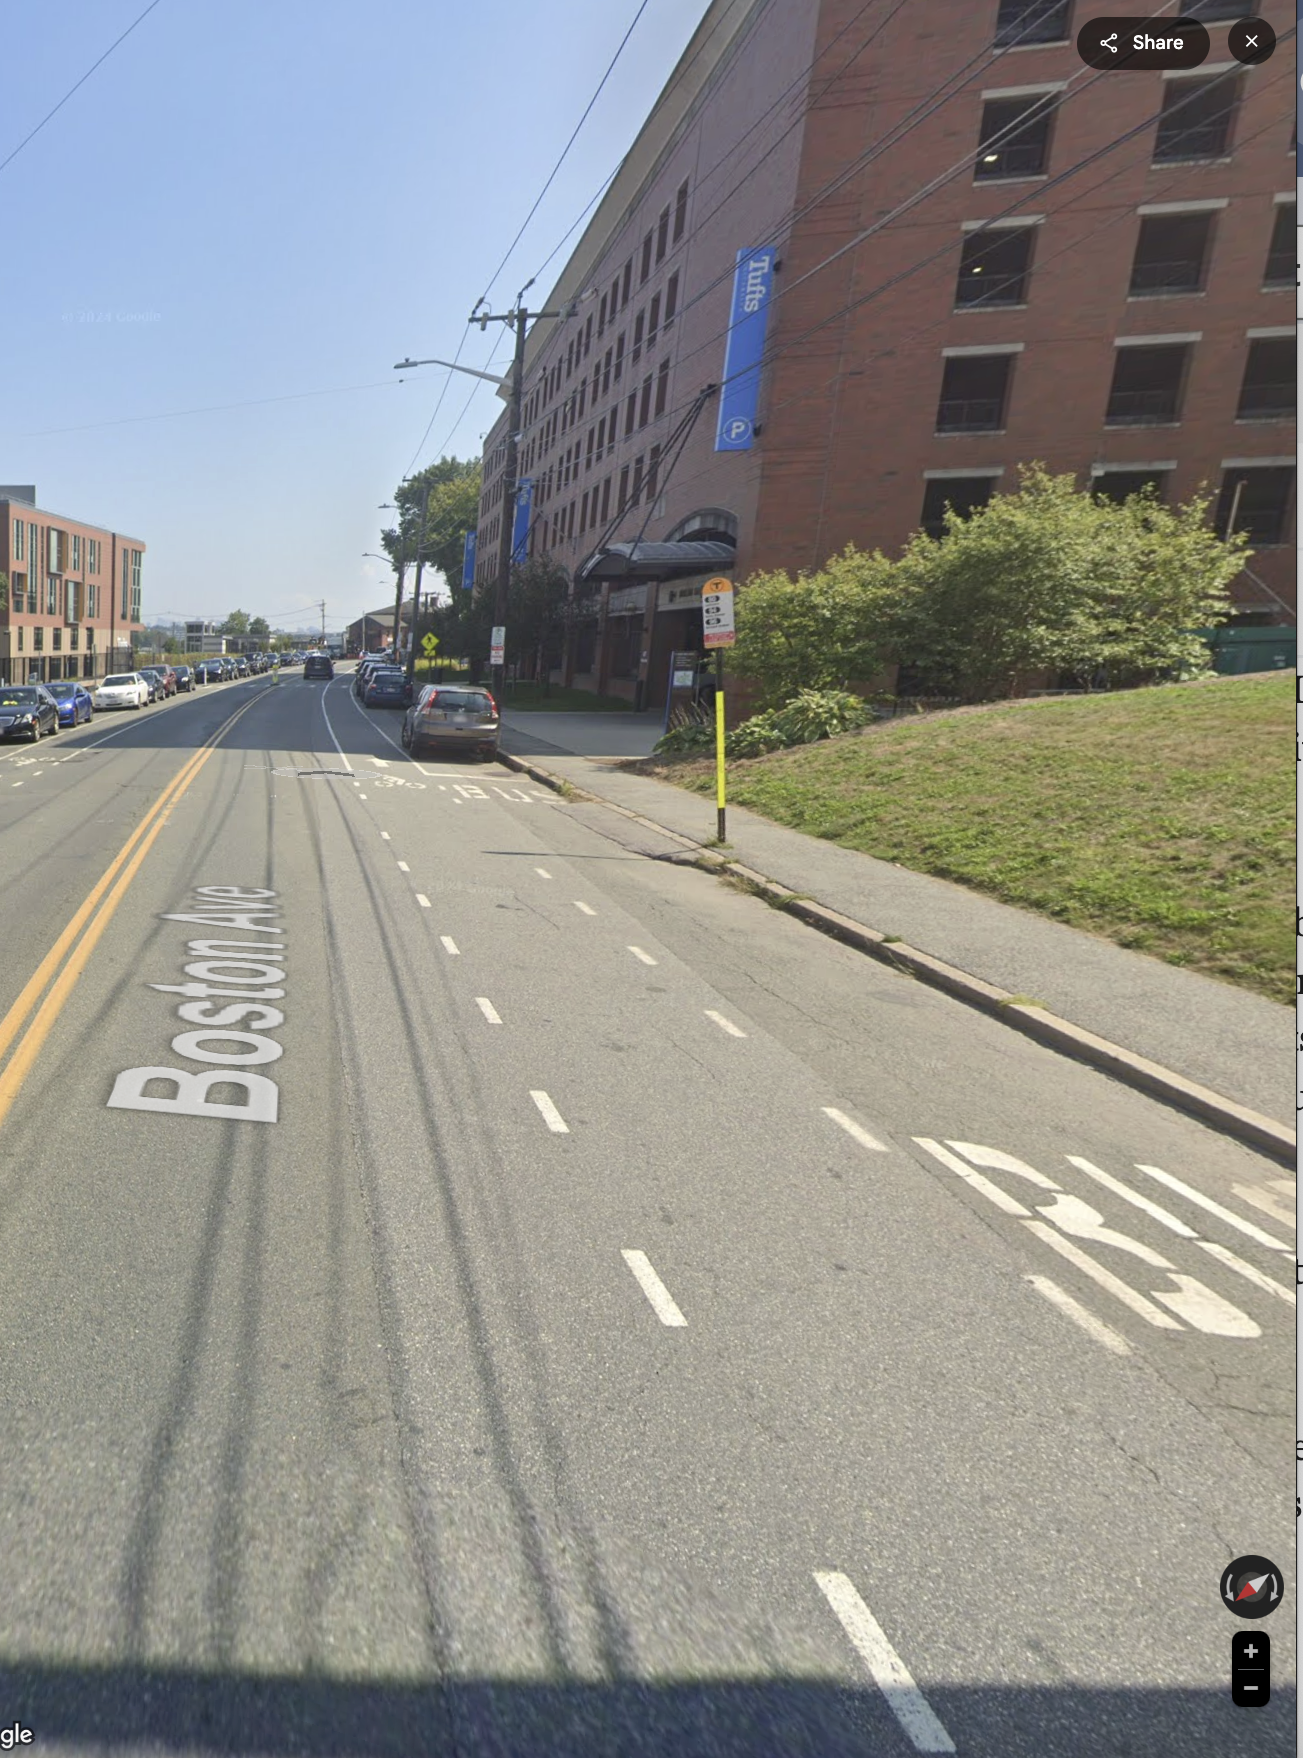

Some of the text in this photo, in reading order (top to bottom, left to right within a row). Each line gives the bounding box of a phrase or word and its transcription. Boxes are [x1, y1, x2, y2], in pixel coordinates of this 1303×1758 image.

[744, 255, 770, 313] Tufts
[452, 784, 568, 805] BUS
[910, 1136, 1296, 1338] BU
